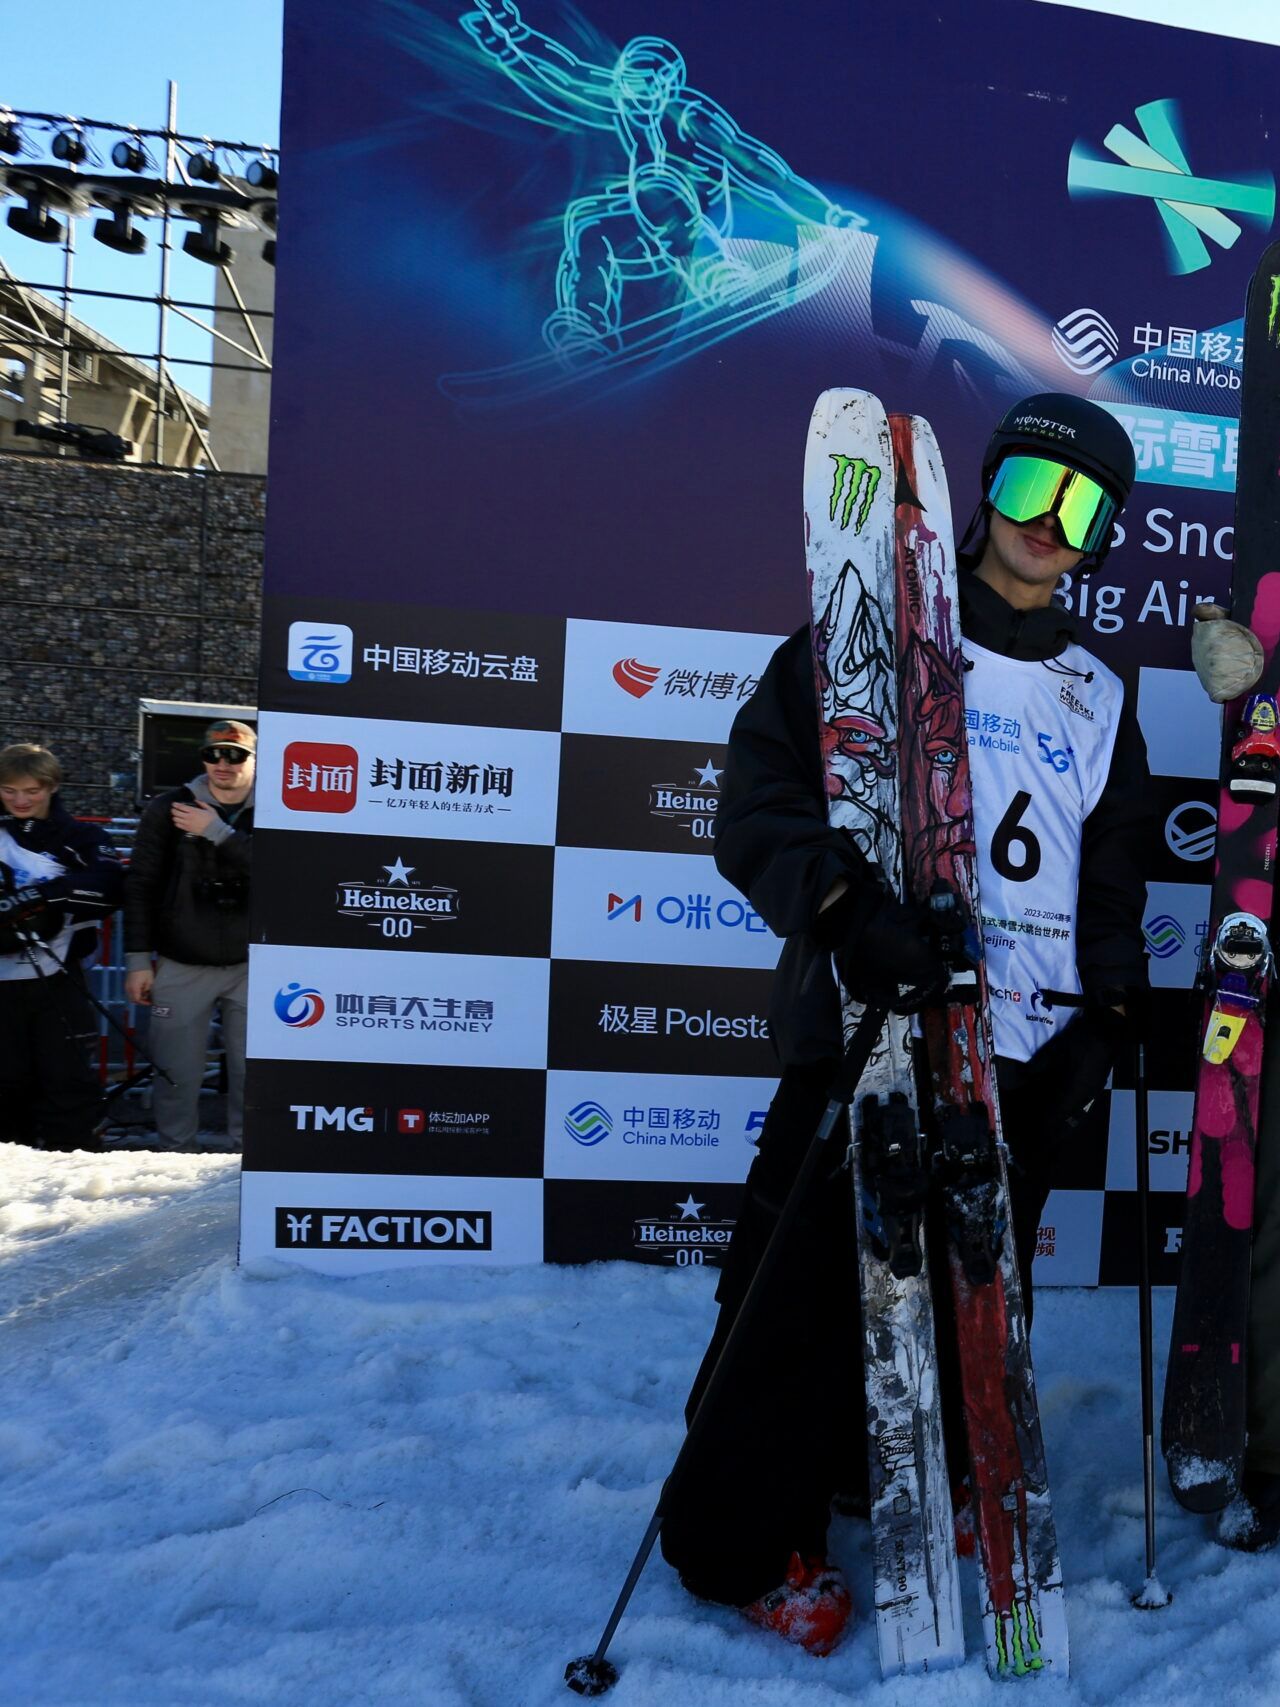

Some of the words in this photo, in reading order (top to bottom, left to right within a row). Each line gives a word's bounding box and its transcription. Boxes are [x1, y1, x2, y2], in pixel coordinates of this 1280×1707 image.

[1133, 322, 1243, 363] 中国移
[1131, 358, 1190, 384] China
[1196, 366, 1241, 390] Mob
[1014, 415, 1076, 439] MONSTER
[903, 546, 922, 616] ATOMIC
[1053, 573, 1126, 634] Big
[362, 644, 539, 682] 中国移动云盘
[663, 668, 762, 701] 微博体
[964, 709, 1022, 739] 国移动
[978, 734, 1020, 755] Mobile
[286, 762, 355, 794] 封面
[369, 757, 514, 798] 封面新闻
[386, 798, 494, 814] 亿万年轻人的生活方式
[656, 790, 718, 811] Heine
[343, 889, 452, 912] Heineken
[382, 917, 412, 938] 0.0
[336, 993, 494, 1020] 体育大生意
[336, 1016, 415, 1030] SPORTS
[420, 1020, 493, 1033] MONEY
[598, 1004, 659, 1034] 极星
[666, 1007, 769, 1039] Polesta
[290, 1105, 374, 1132] TMG
[428, 1111, 490, 1124] 体坛加APP
[623, 1106, 720, 1131] 中国移动
[622, 1131, 666, 1146] China
[670, 1133, 720, 1147] Mobile
[322, 1215, 484, 1244] FACTION
